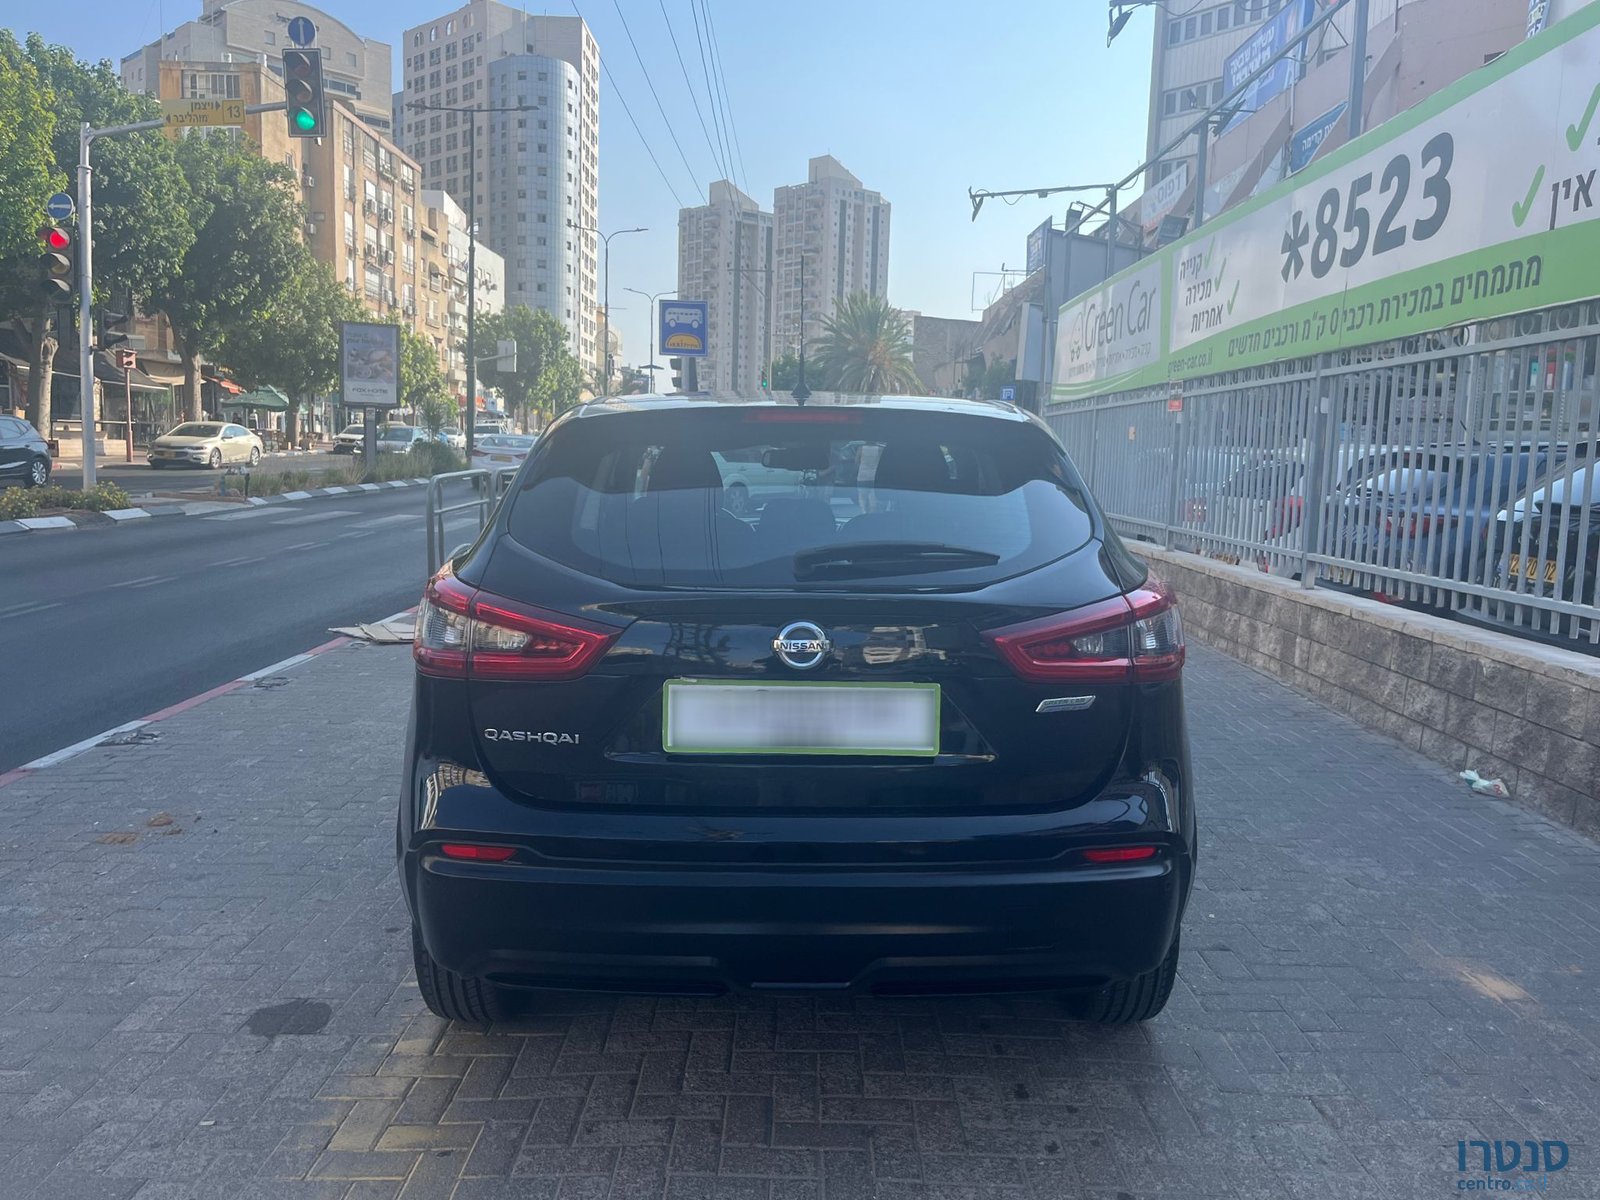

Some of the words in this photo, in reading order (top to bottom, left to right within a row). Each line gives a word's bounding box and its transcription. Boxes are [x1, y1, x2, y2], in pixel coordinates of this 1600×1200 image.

[172, 112, 208, 123] מוהליבר
[191, 101, 214, 112] ויצמן
[227, 105, 241, 118] 13
[1549, 168, 1597, 231] אין
[1180, 253, 1203, 281] קנייה
[1450, 255, 1542, 305] מתמחים
[1185, 278, 1212, 307] מכירה
[1377, 282, 1445, 324] במכירת
[1085, 303, 1124, 352] Green
[1127, 280, 1157, 336] Car
[1190, 304, 1224, 334] אחריות
[1227, 332, 1261, 358] חדשים
[1263, 320, 1298, 350] ורכבים
[1167, 346, 1213, 377] green-car.co.il
[780, 642, 825, 650] NISSAN
[484, 728, 580, 746] QASHQAI
